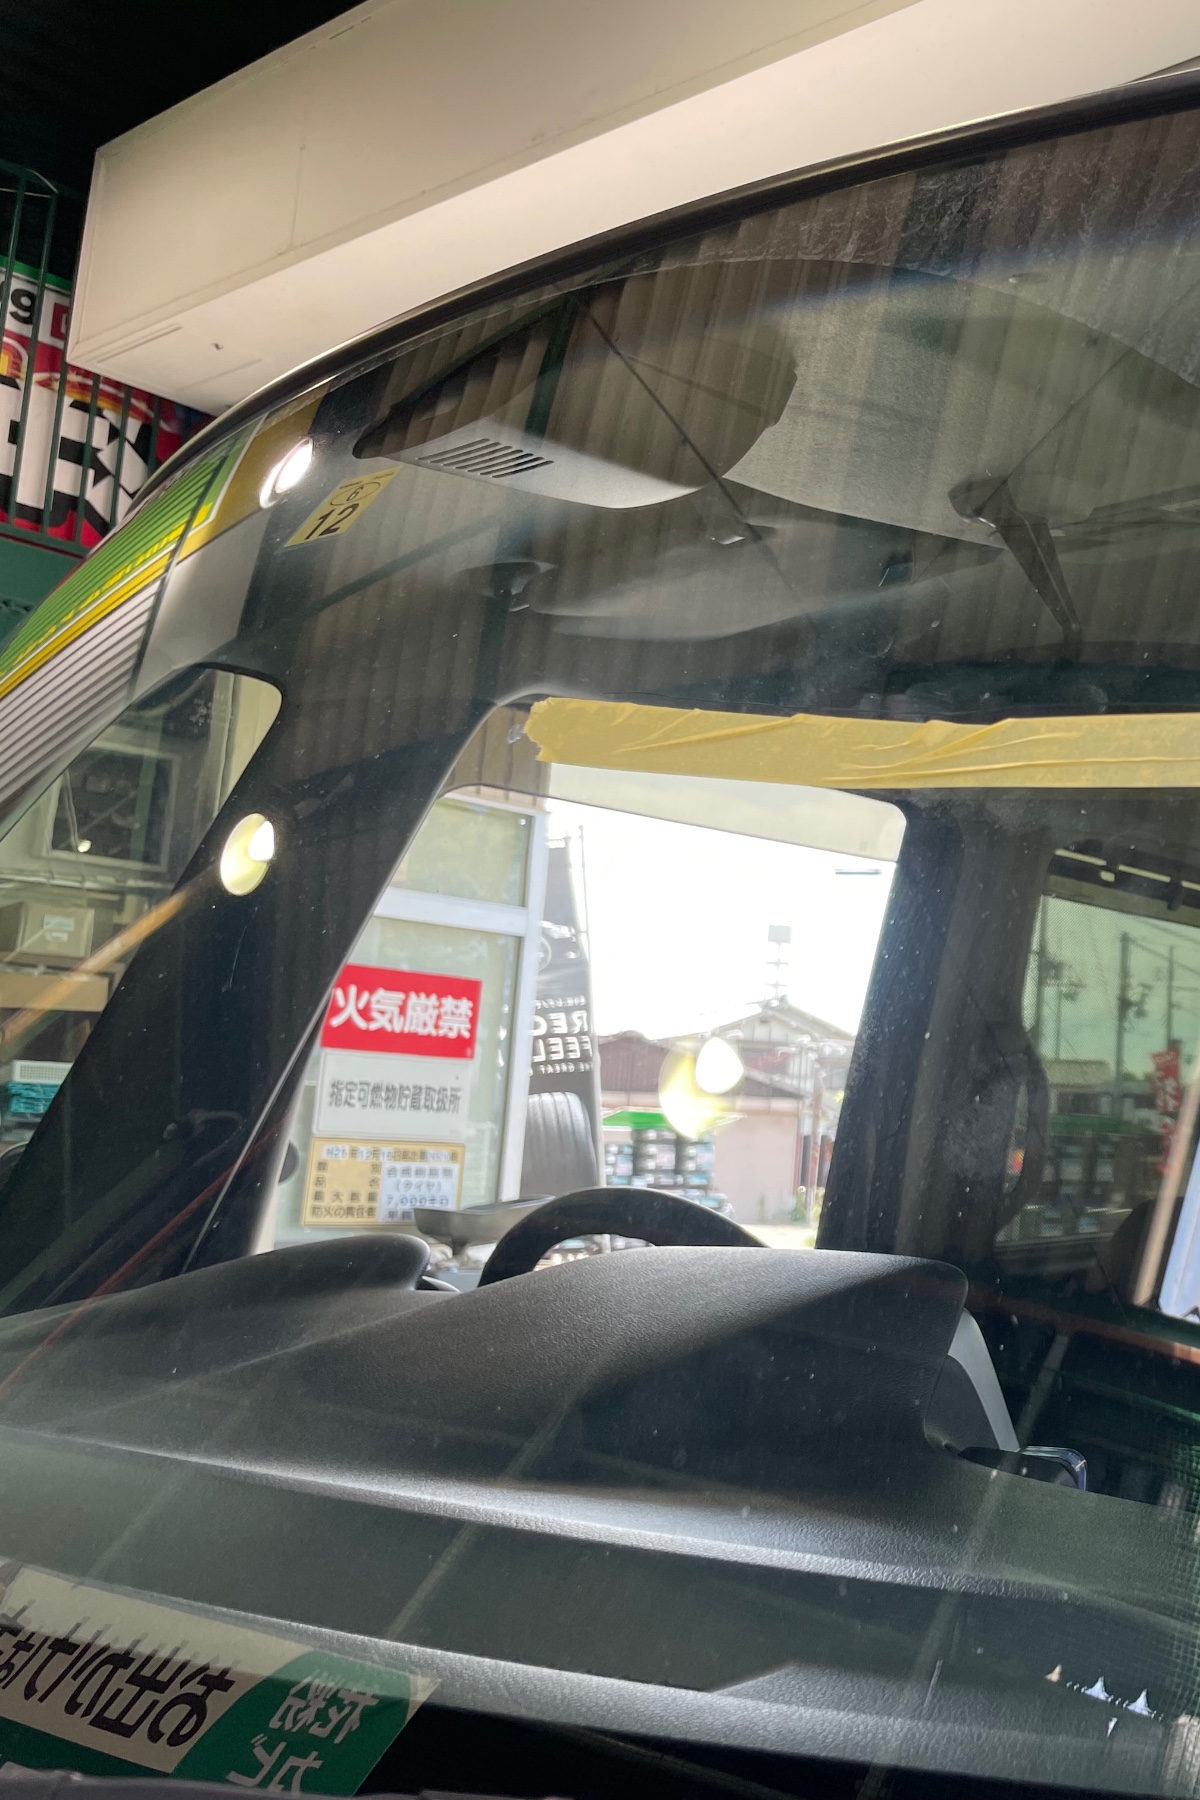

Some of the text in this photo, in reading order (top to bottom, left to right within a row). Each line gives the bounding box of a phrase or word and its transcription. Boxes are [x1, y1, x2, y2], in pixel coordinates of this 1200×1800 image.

[346, 485, 364, 501] 6
[304, 503, 360, 541] 12
[329, 984, 474, 1039] 火気厳禁
[328, 1080, 462, 1114] 指定可燃物貯蔵取扱所
